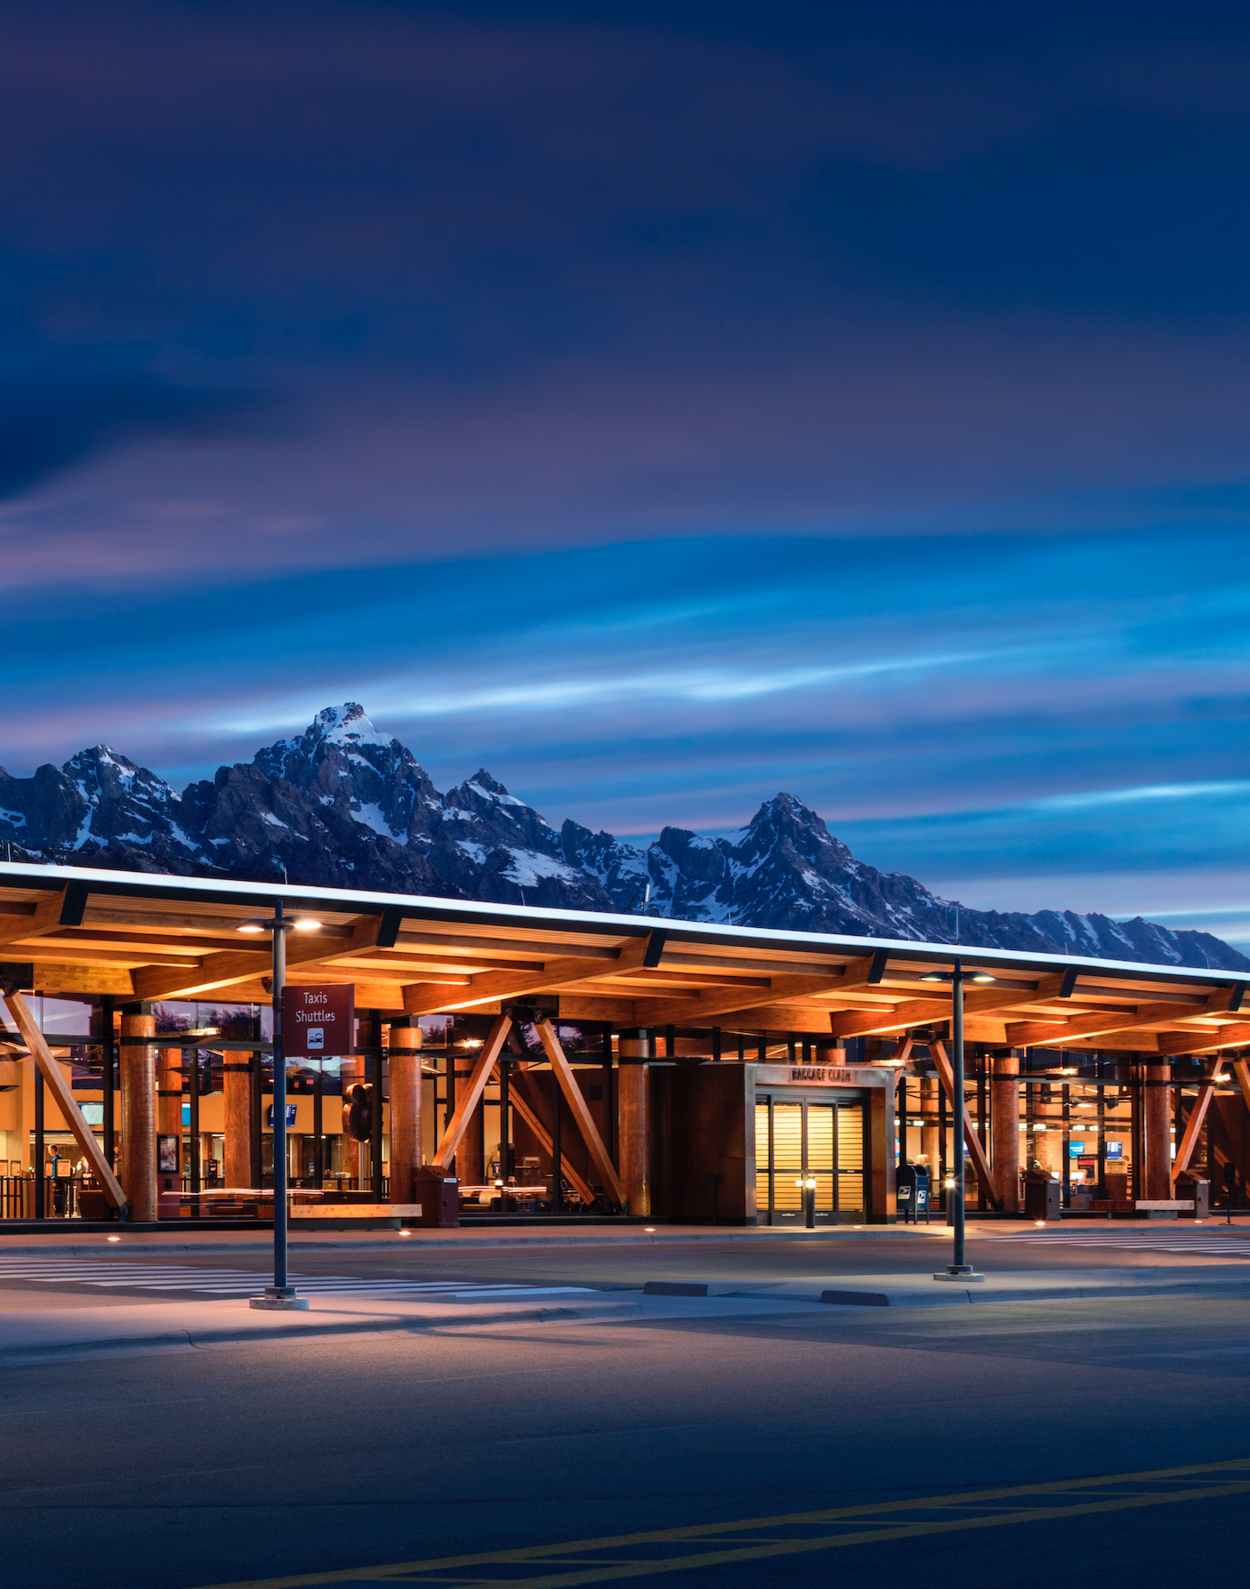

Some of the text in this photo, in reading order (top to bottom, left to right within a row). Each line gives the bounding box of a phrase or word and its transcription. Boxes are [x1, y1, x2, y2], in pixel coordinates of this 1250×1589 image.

[303, 991, 328, 1004] Taxis
[295, 1010, 336, 1023] Shuttles
[792, 1067, 851, 1082] BAGGAGE CLAIM
